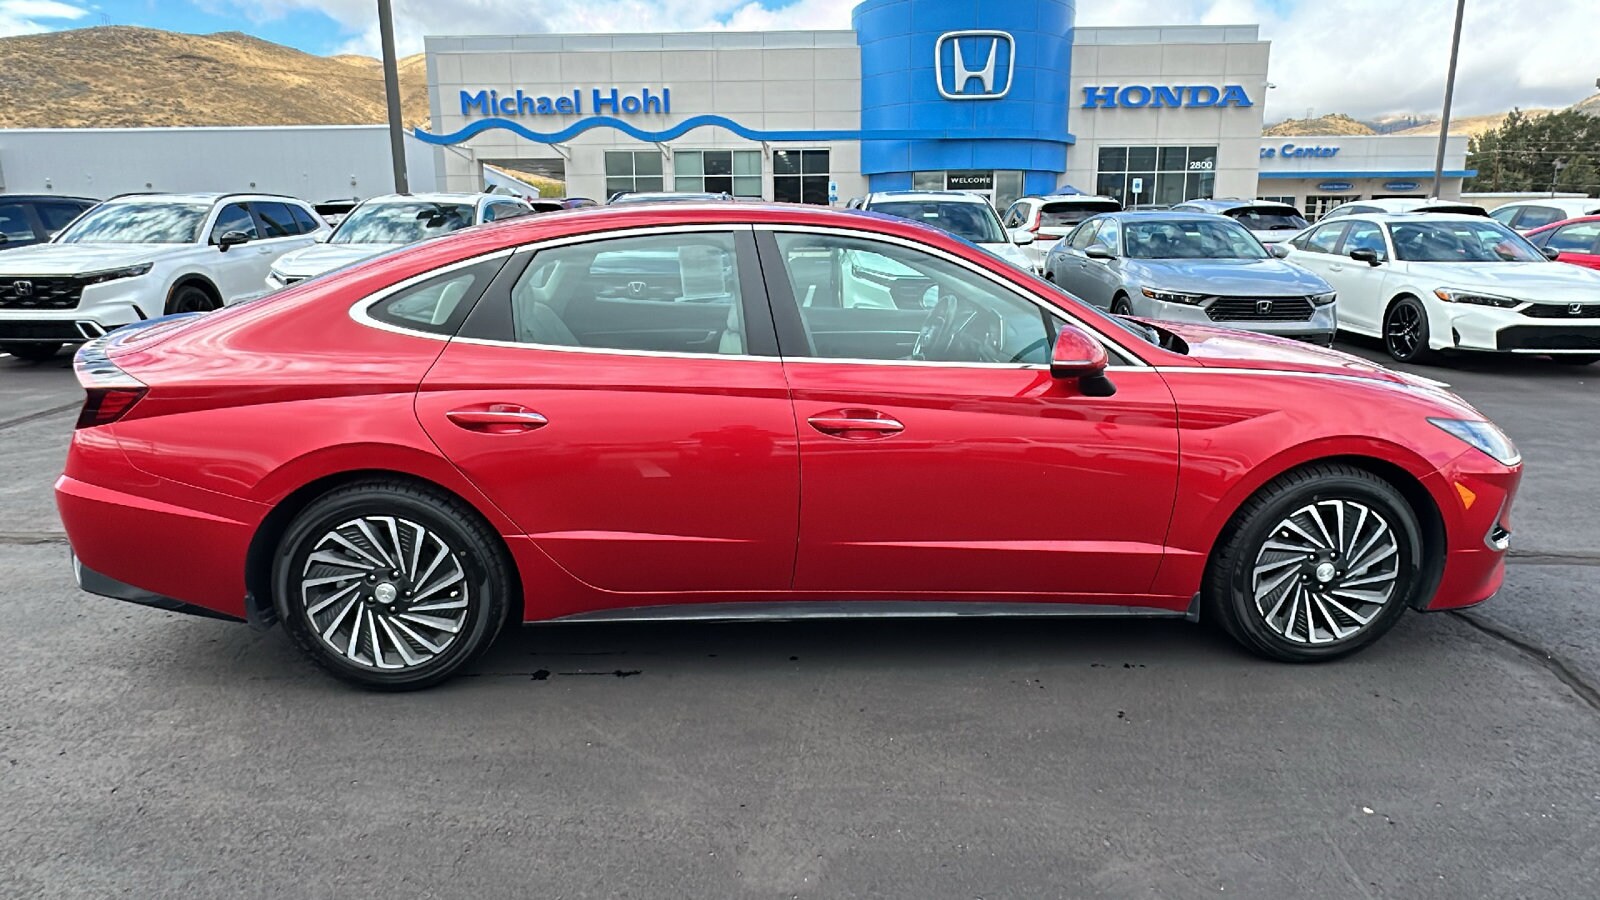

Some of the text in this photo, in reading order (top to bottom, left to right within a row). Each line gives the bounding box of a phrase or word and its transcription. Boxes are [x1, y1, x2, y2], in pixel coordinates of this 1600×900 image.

[460, 88, 671, 115] Michael Hohl
[1082, 85, 1254, 109] HONDA
[1281, 144, 1340, 158] Center
[1189, 161, 1213, 170] 2800
